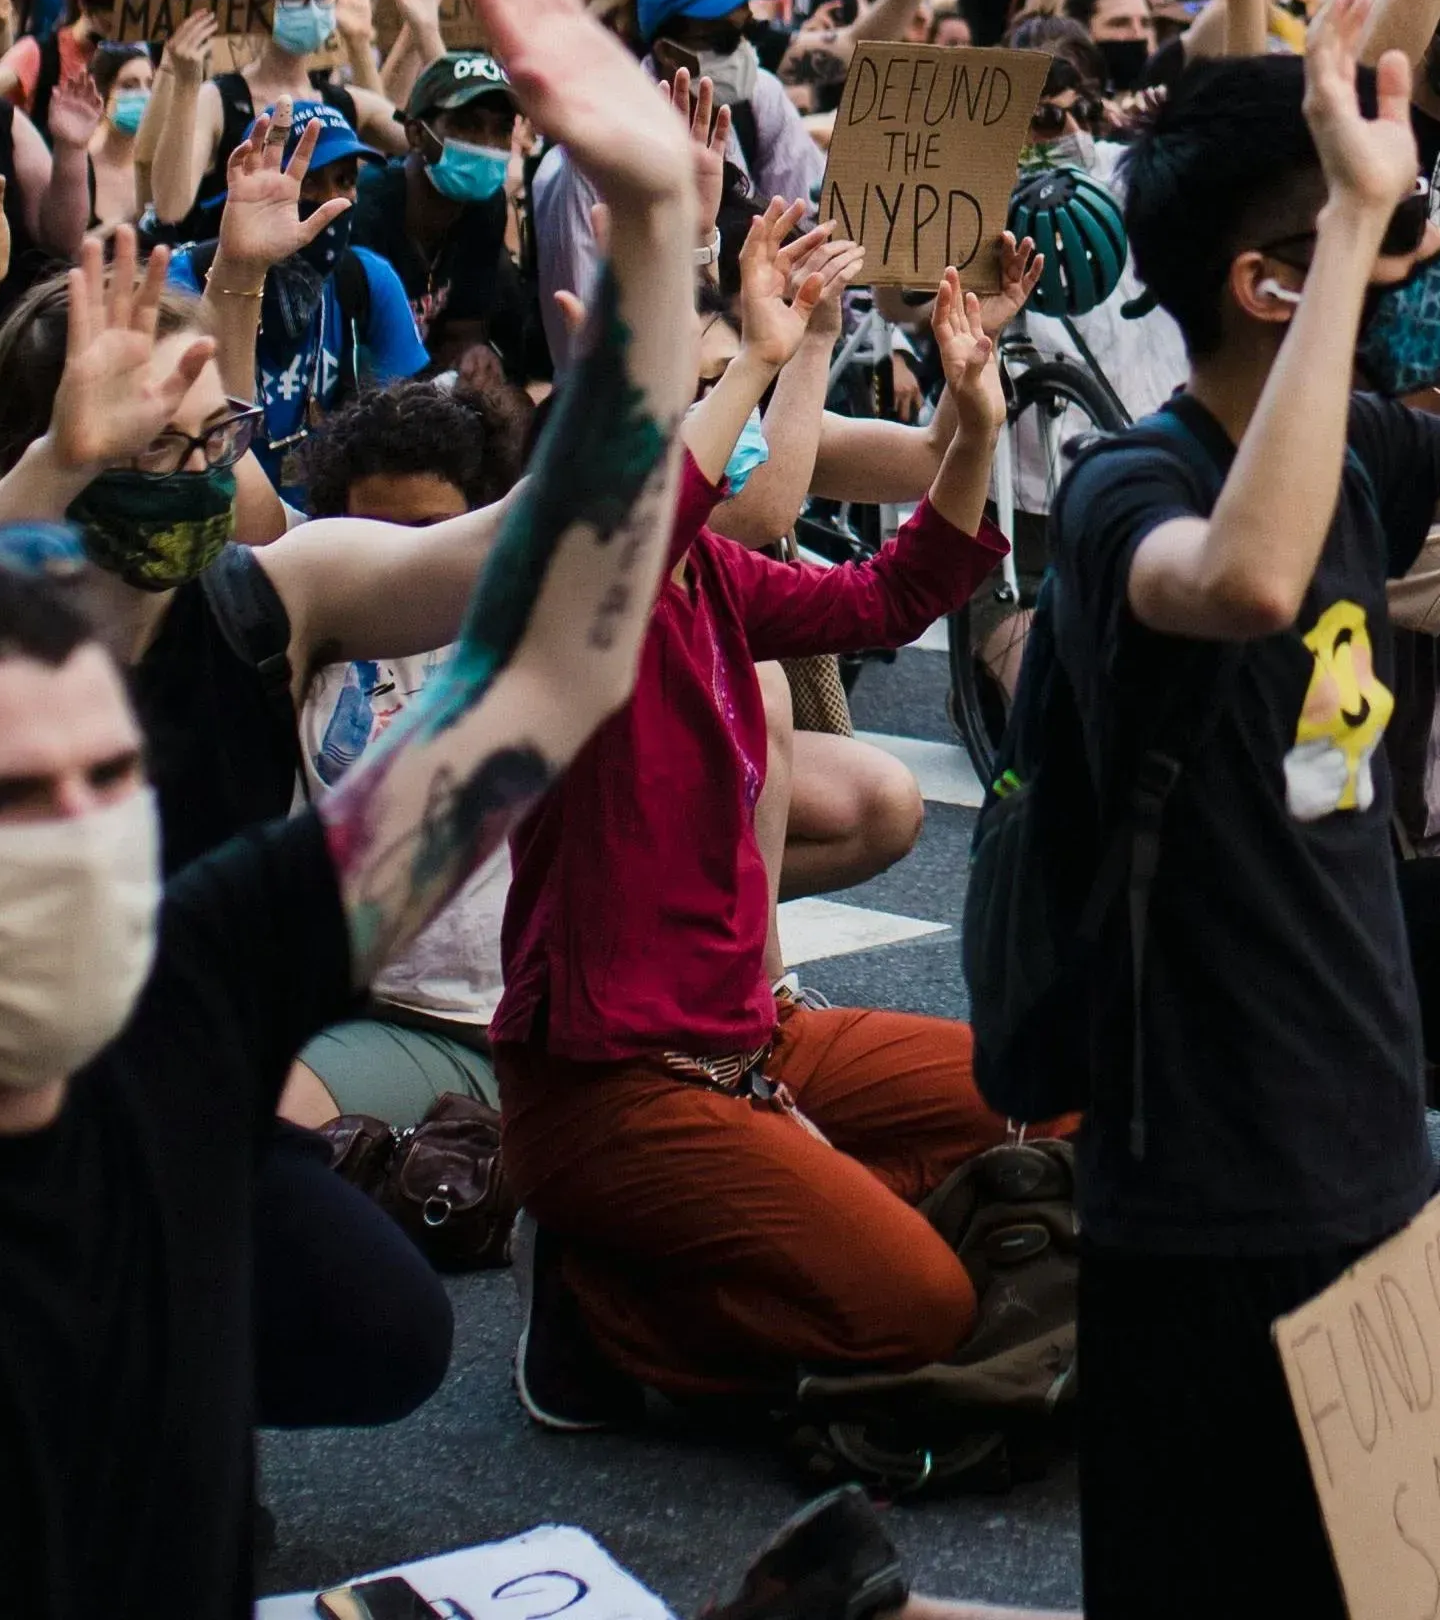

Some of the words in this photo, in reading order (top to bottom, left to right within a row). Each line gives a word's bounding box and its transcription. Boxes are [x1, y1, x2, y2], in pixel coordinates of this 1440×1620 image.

[848, 56, 1012, 127] DEFUND
[883, 131, 941, 176] THE
[827, 181, 983, 273] NYPD
[1291, 1274, 1434, 1489] FUND
